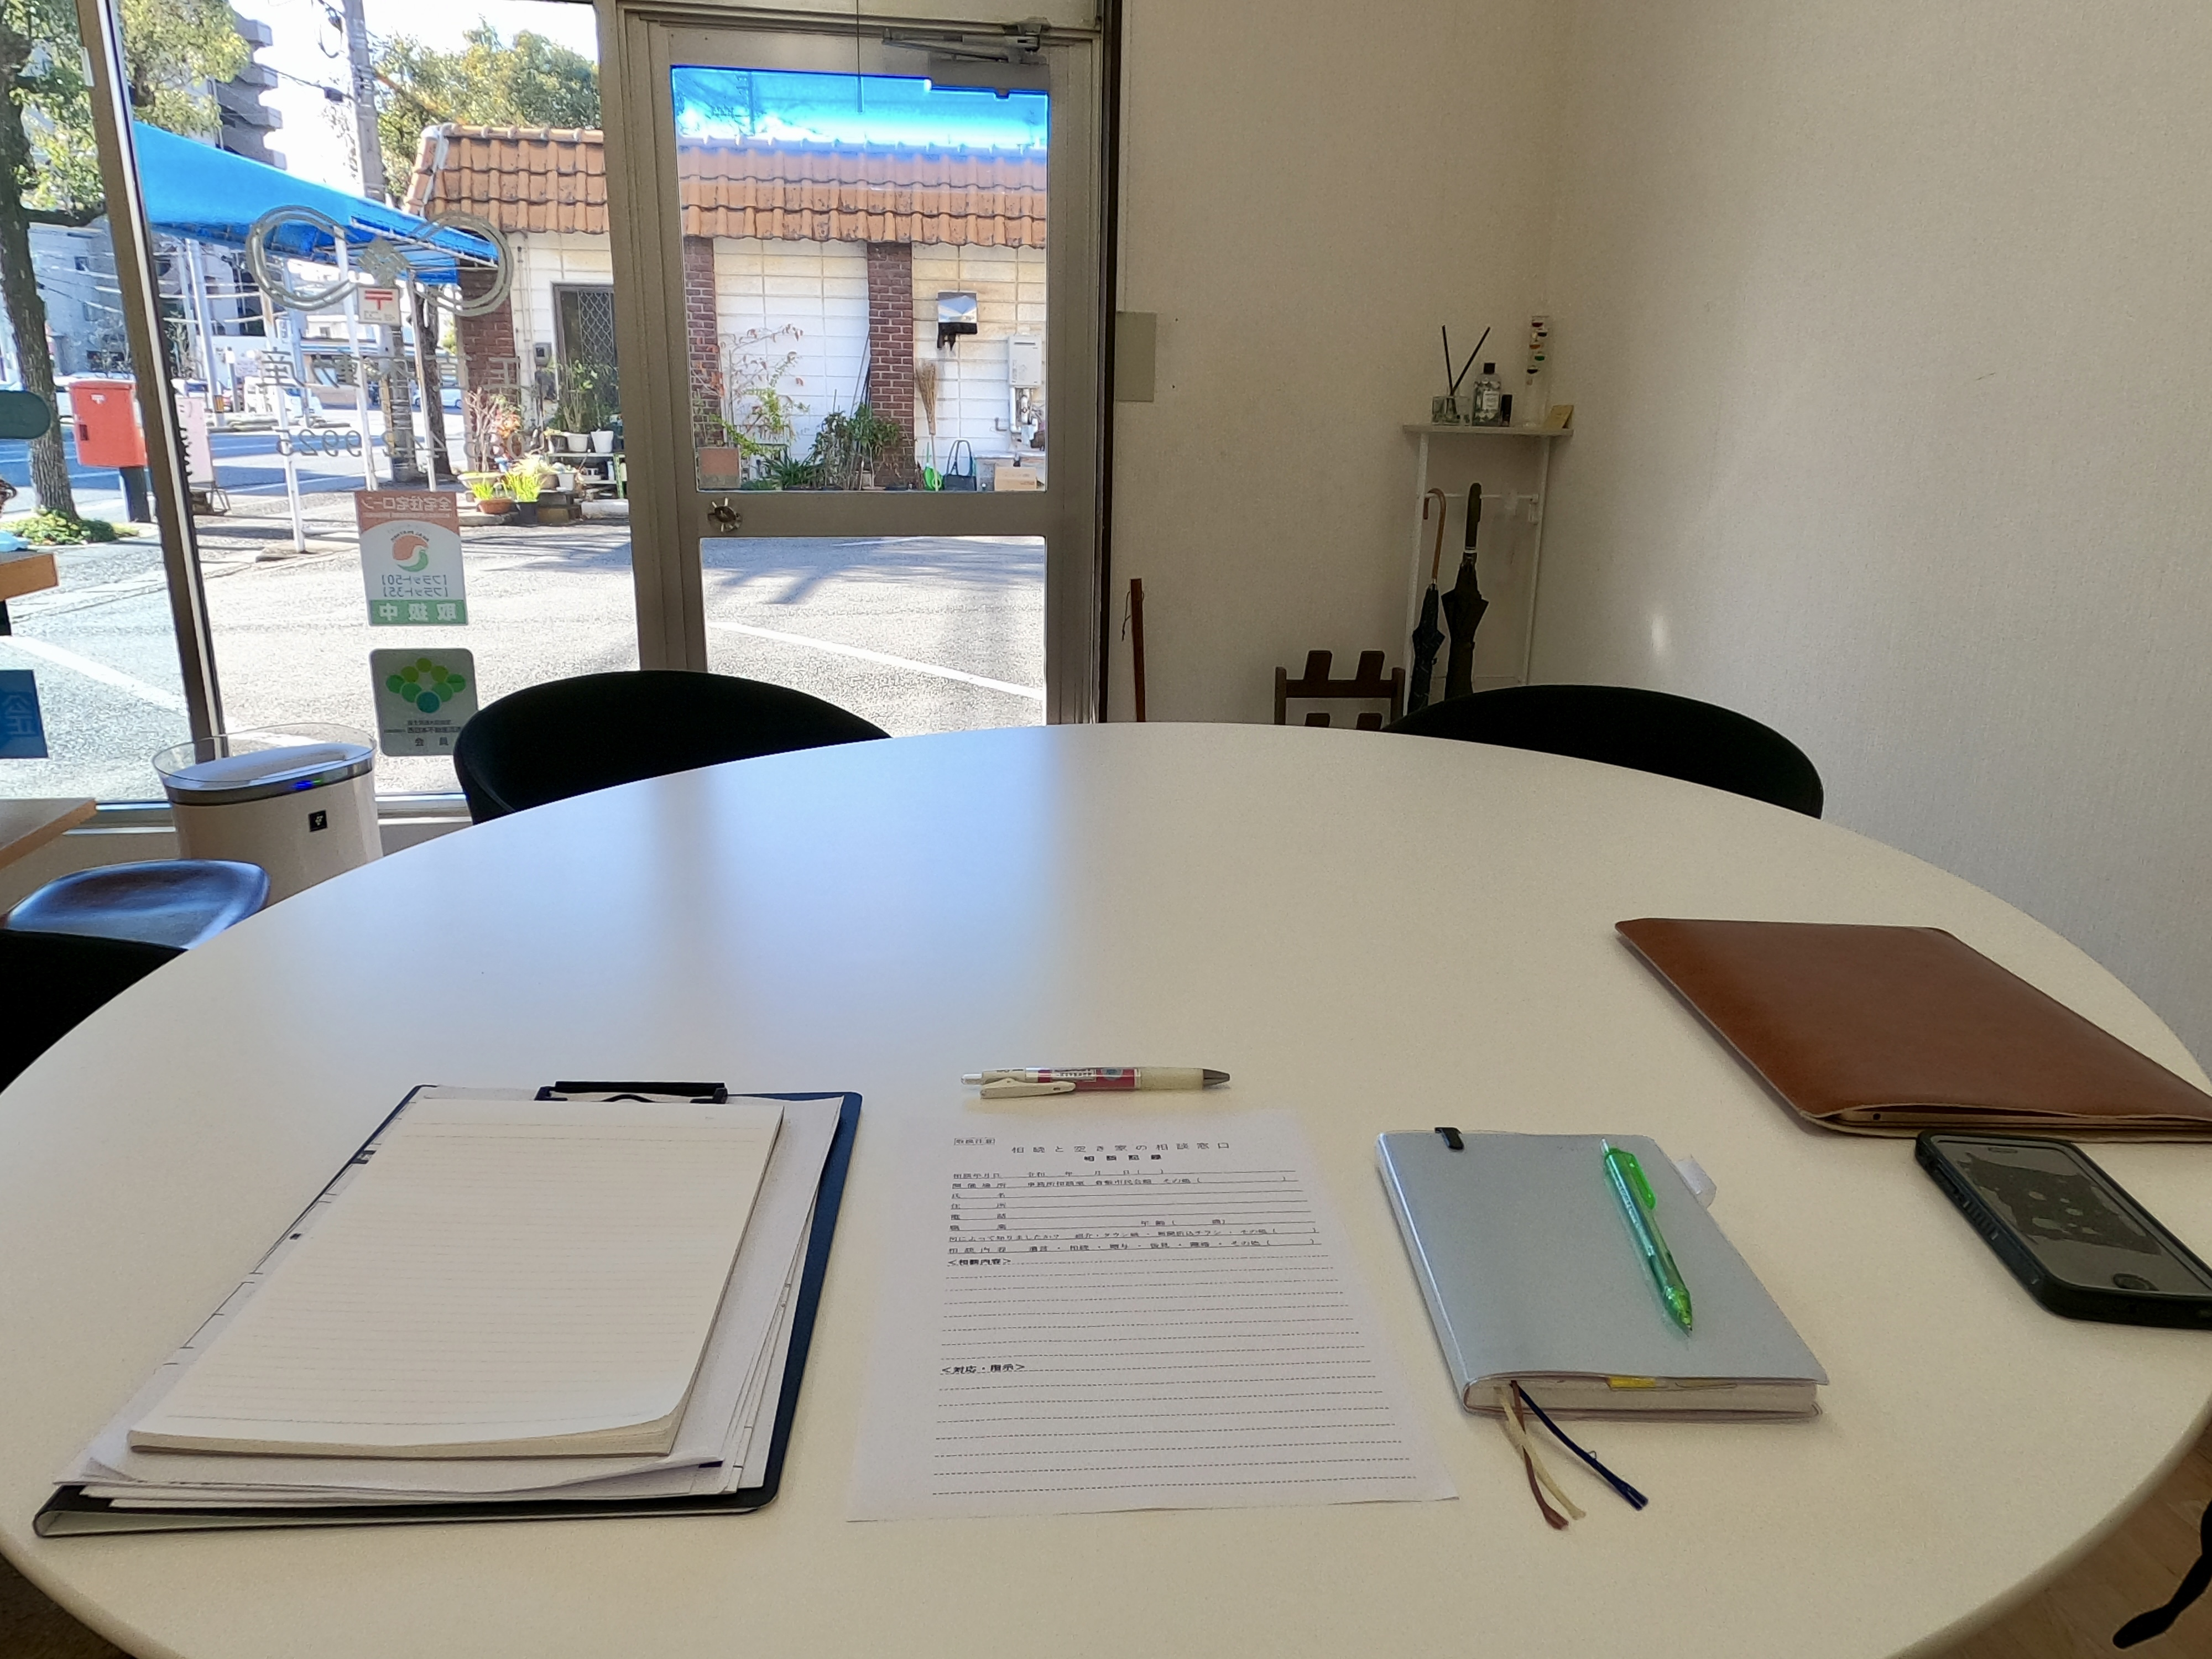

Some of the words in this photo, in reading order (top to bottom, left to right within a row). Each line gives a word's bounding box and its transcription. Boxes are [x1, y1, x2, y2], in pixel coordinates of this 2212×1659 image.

[1011, 1142, 1229, 1154] 相続と空き家の相談窓口
